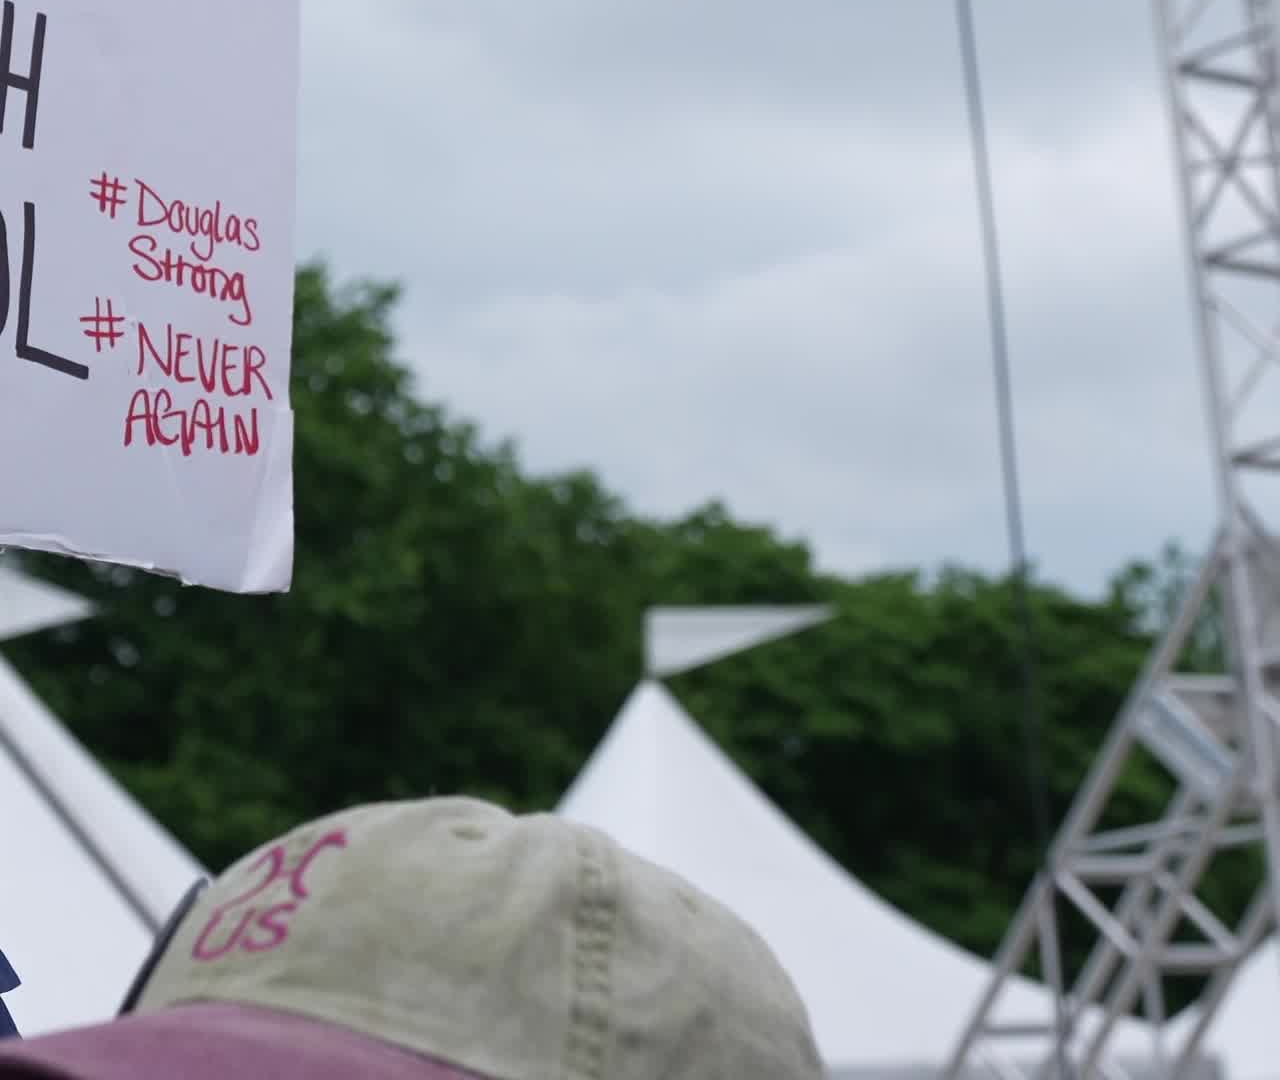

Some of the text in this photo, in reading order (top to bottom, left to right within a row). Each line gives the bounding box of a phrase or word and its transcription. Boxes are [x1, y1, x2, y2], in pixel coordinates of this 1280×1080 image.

[89, 171, 262, 262] #Douglas
[128, 233, 254, 328] Strong
[123, 387, 262, 458] AGAIN
